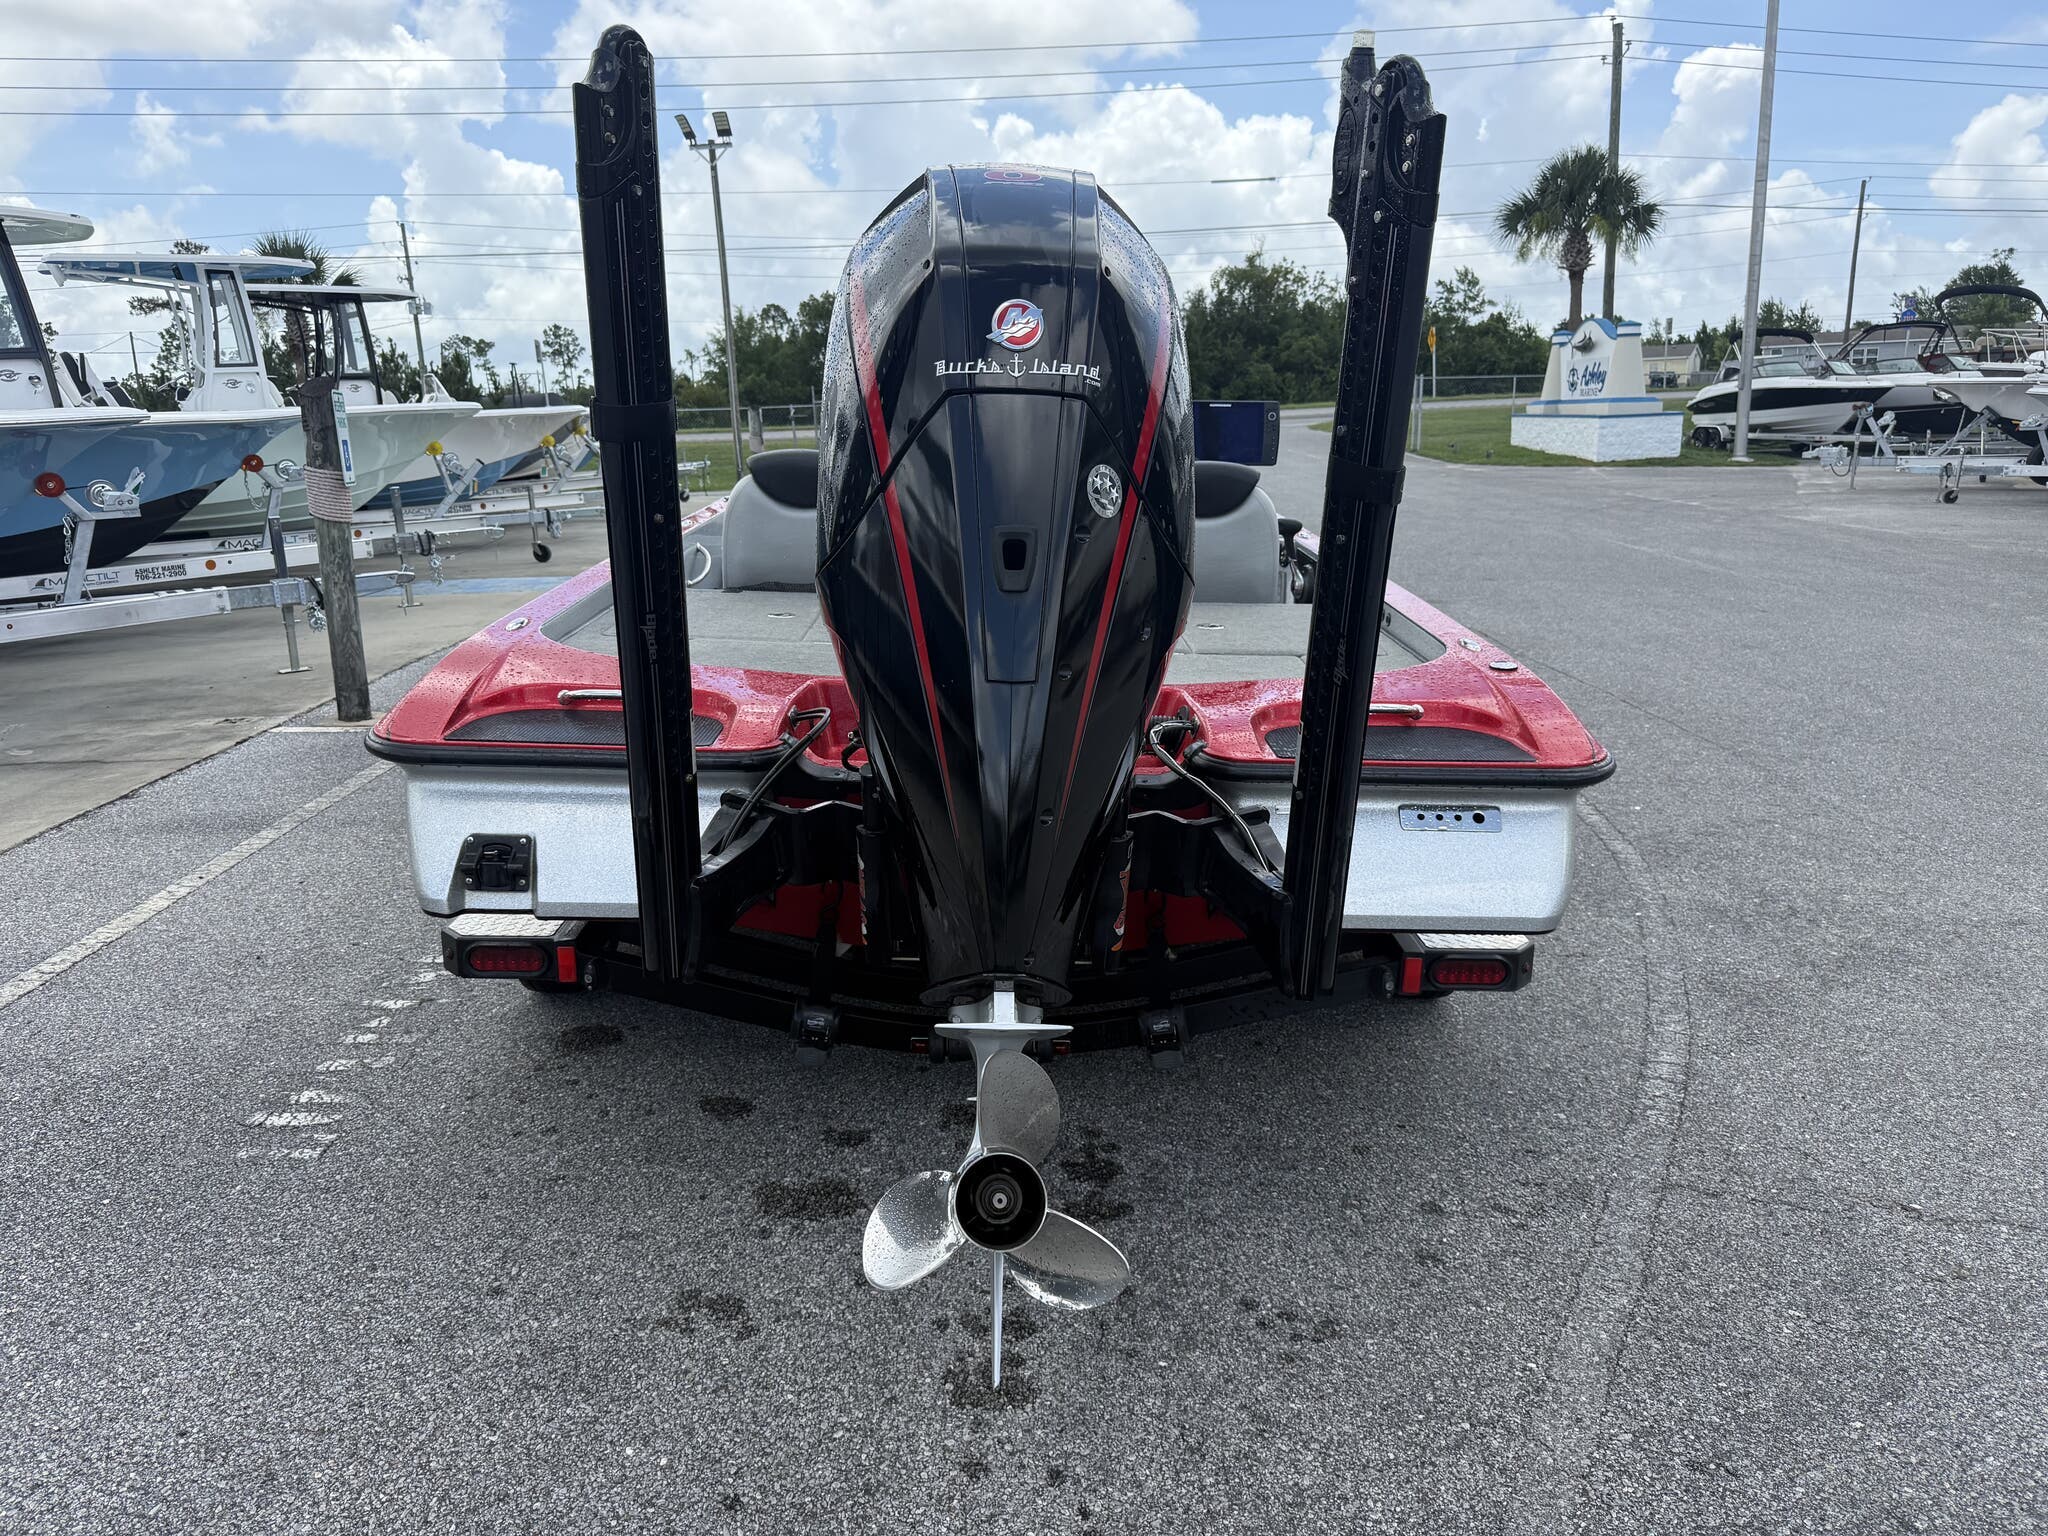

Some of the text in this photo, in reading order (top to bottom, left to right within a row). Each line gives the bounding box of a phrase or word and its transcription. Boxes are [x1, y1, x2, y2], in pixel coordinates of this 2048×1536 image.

[934, 358, 1101, 381] Buck's Island
[134, 563, 187, 576] ASHLEY MARINE
[135, 569, 187, 581] 706-221-2900
